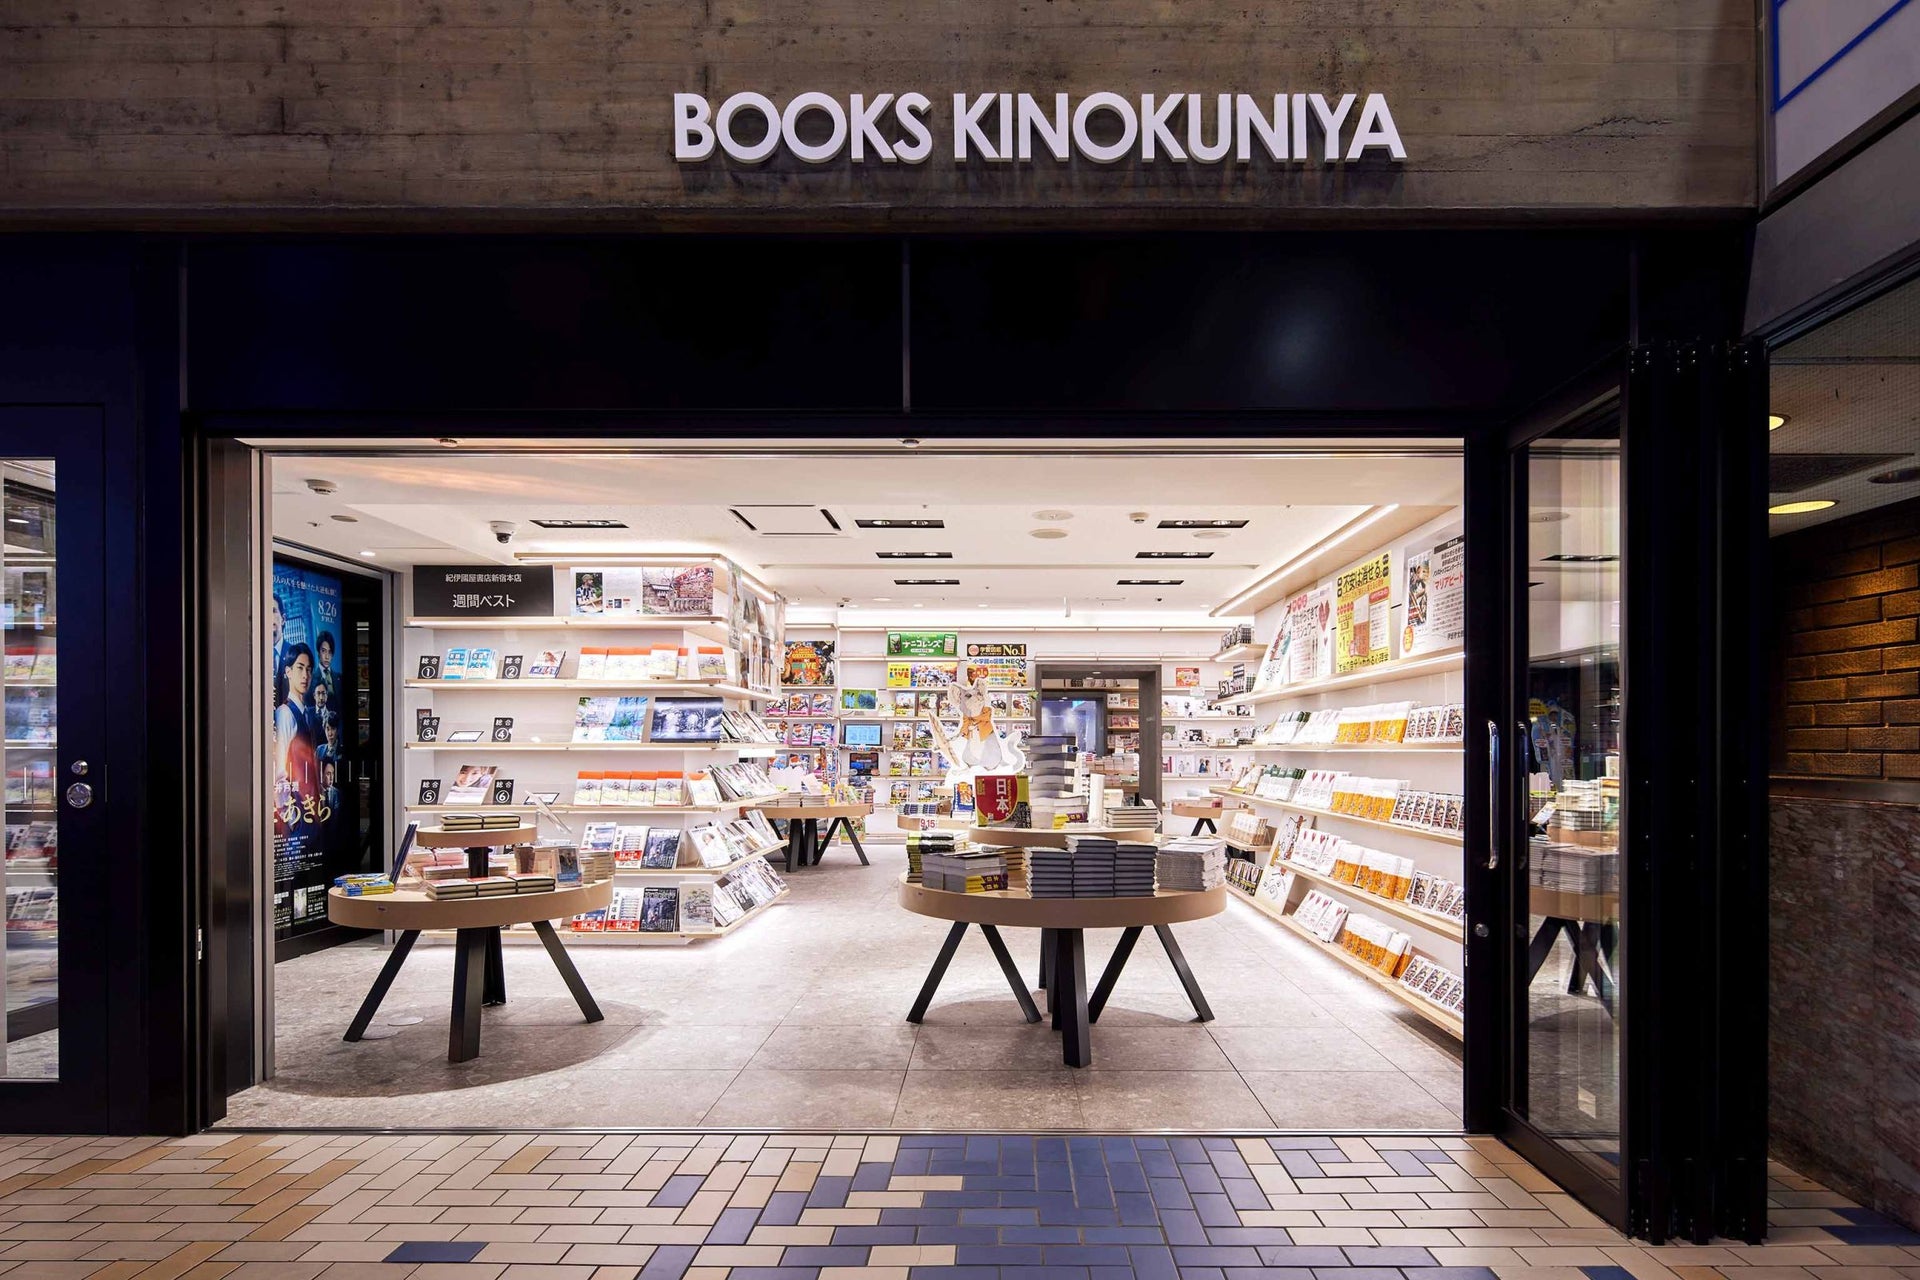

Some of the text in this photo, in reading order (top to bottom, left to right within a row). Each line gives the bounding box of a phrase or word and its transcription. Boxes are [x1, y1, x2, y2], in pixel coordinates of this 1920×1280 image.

[673, 91, 1407, 164] BOOKS KINOKUNIYA
[453, 594, 515, 608] 週間ベスト
[318, 600, 337, 617] 8.26
[1003, 644, 1026, 656] No.1
[889, 671, 910, 679] LIVE
